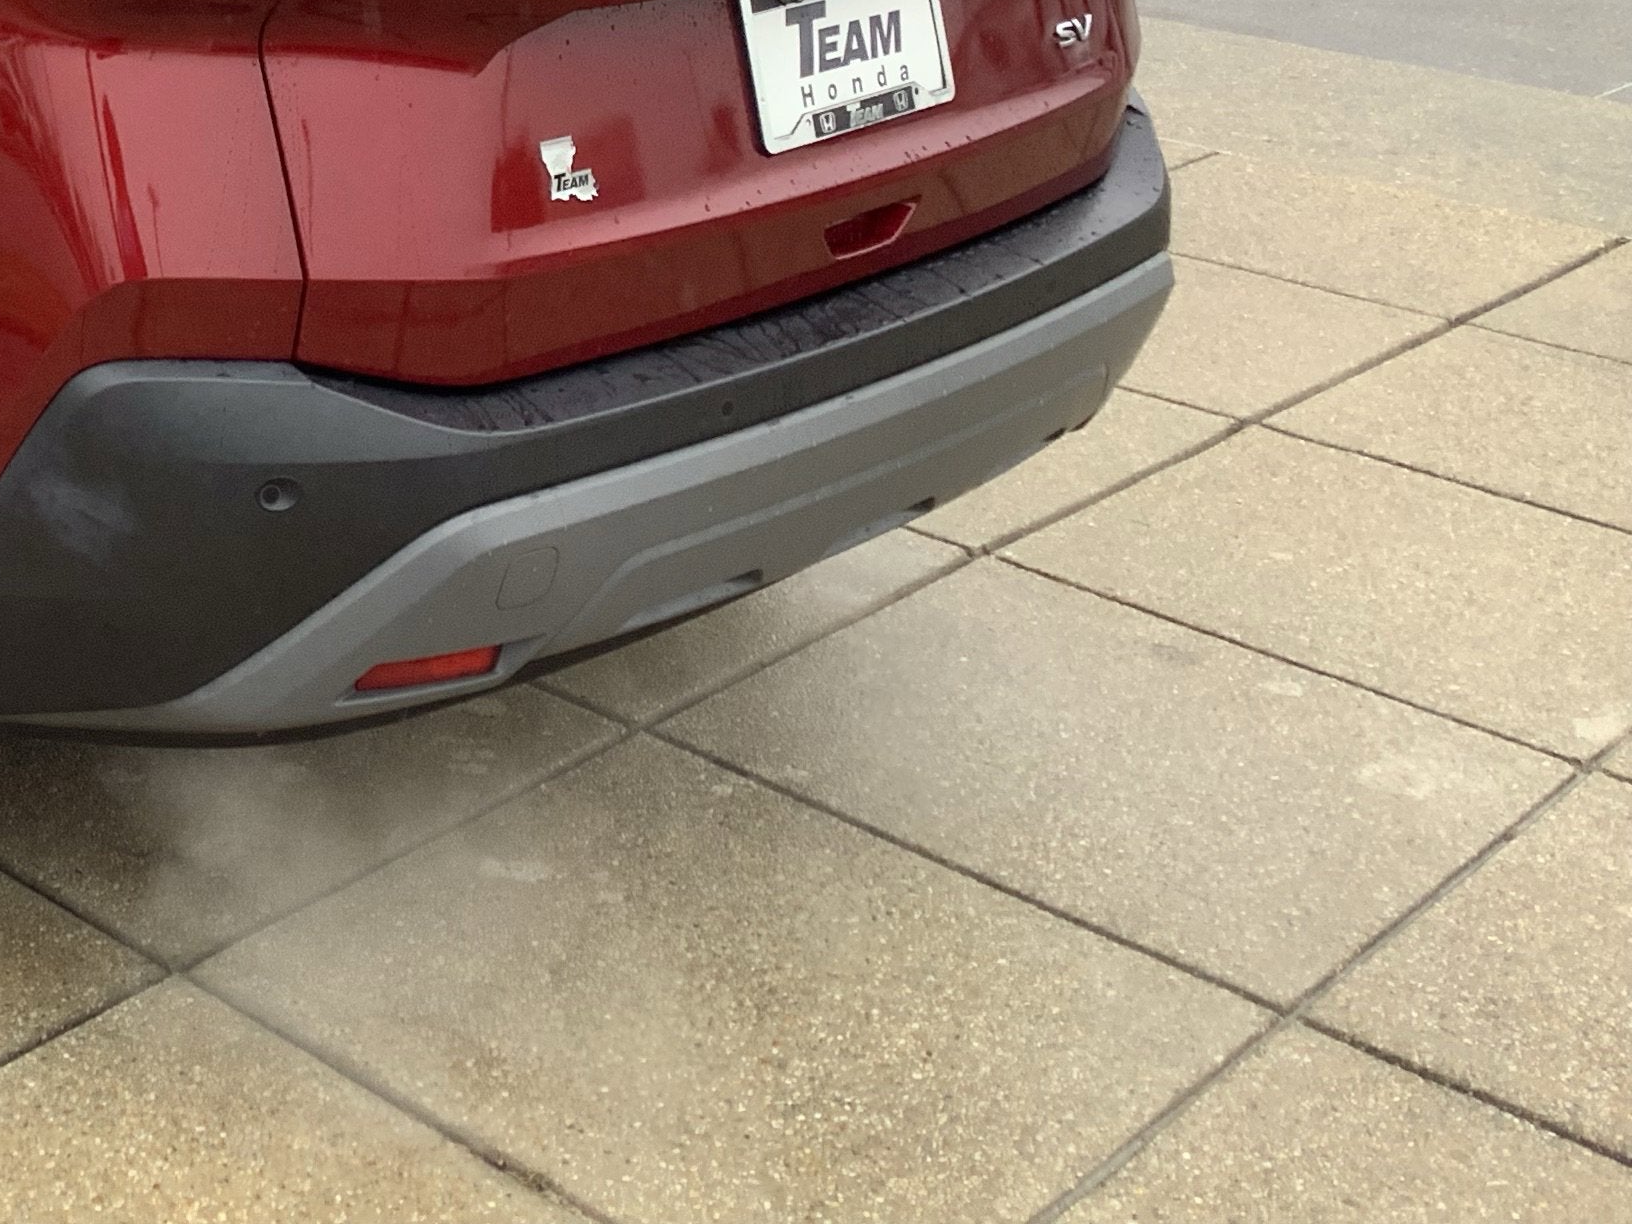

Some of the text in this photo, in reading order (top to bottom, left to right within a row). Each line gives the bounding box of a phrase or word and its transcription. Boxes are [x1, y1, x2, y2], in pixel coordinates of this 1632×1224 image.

[785, 0, 902, 79] TEAM
[1055, 13, 1093, 48] SV
[800, 64, 910, 108] Honda
[846, 101, 885, 128] TEAM
[553, 172, 590, 192] TEAM
